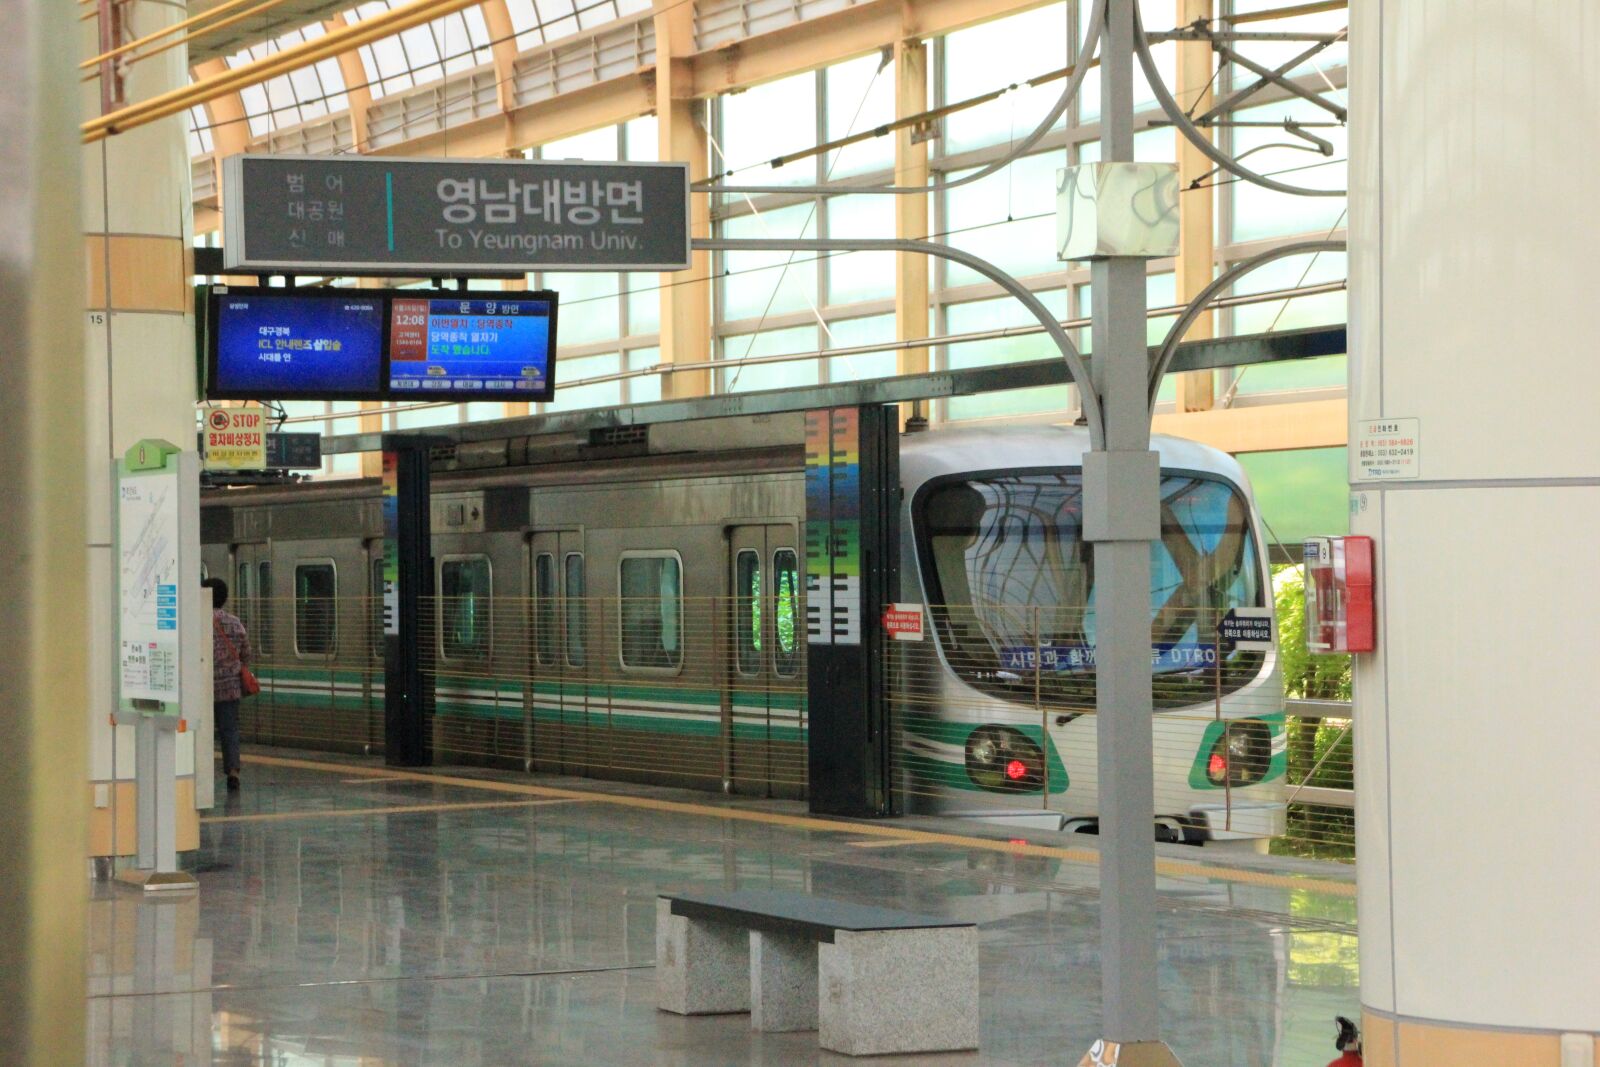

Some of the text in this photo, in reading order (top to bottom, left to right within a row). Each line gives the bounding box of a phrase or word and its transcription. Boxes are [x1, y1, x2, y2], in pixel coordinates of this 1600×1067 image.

[287, 200, 344, 221] 대공원
[436, 178, 645, 225] 영남대방면
[435, 228, 643, 255] To Yeungnam Univ.
[91, 315, 103, 324] 15
[396, 314, 425, 326] 12:08
[232, 414, 260, 429] STOP
[209, 432, 261, 447] 열차비상정지
[1010, 650, 1059, 669] 시민과
[1171, 648, 1216, 663] DTRO
